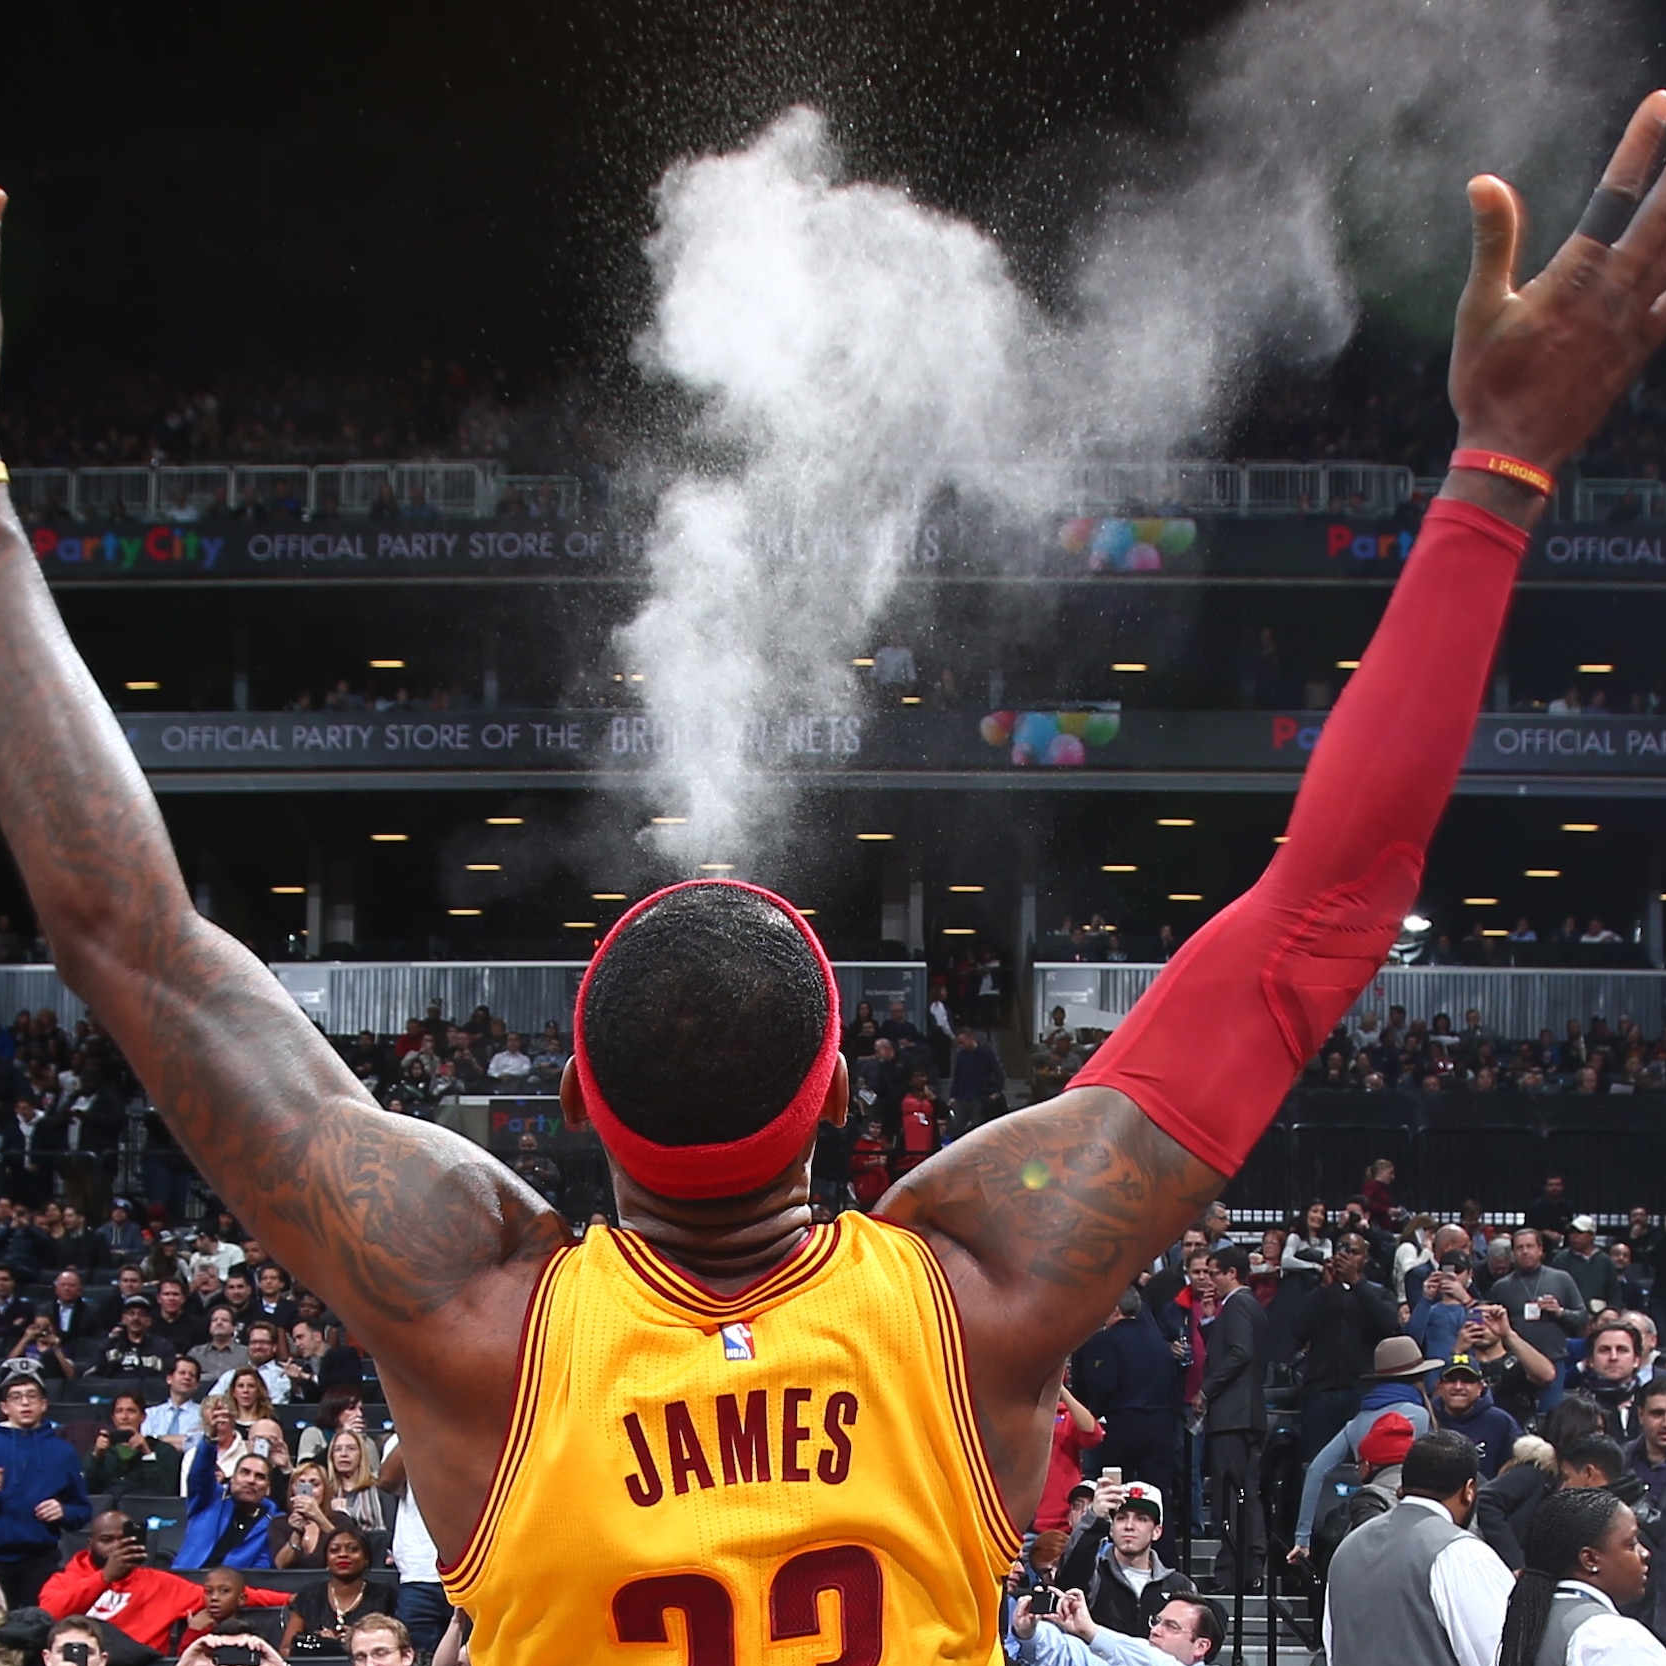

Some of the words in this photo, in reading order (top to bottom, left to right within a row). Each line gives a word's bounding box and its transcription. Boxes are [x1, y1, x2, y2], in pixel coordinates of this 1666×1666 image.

[1498, 460, 1552, 492] PROMIS
[247, 533, 368, 563] OFFICIAL
[376, 532, 457, 560] PARTY
[468, 532, 554, 560] STORE
[563, 531, 605, 559] OF
[1545, 536, 1666, 564] OFFICIAL
[161, 725, 282, 753] OFFICIAL
[291, 725, 374, 752] PARTY
[384, 724, 470, 751] STORE
[480, 723, 521, 751] OF
[528, 723, 582, 750] THE
[1493, 728, 1617, 756] OFFICIAL
[726, 1347, 747, 1359] NBA
[621, 1387, 858, 1507] JAMES
